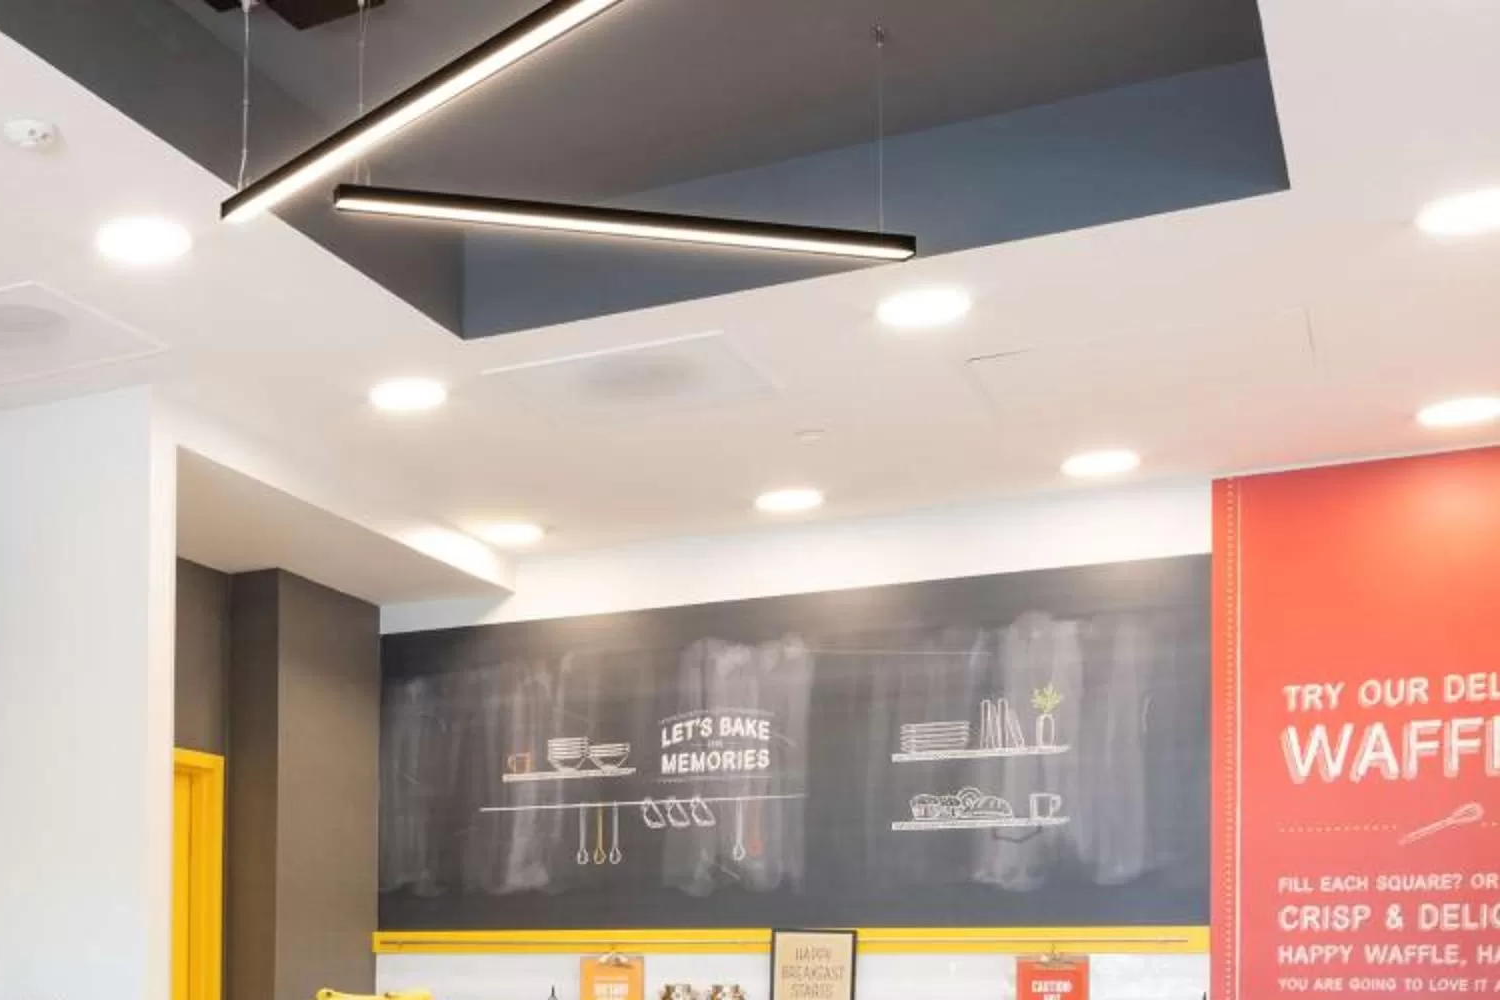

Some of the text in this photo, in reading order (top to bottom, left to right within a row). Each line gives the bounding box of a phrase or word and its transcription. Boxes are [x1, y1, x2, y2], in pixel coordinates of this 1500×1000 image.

[1282, 671, 1500, 713] TRY OUR DEL
[661, 716, 771, 749] LET'S BAKE
[661, 748, 771, 775] MEMORIES
[1278, 872, 1499, 894] FILL EACH SQUARE? OR
[1278, 903, 1372, 933] CRISP
[1385, 902, 1405, 932] &
[1277, 944, 1353, 965] HAPPY
[1363, 943, 1468, 967] WAFFLE,
[1278, 978, 1308, 993] YOU
[1313, 978, 1343, 992] ARE
[1348, 977, 1397, 993] GOING
[1404, 977, 1423, 992] TO
[1429, 976, 1469, 993] LOVE
[1474, 978, 1488, 992] IT
